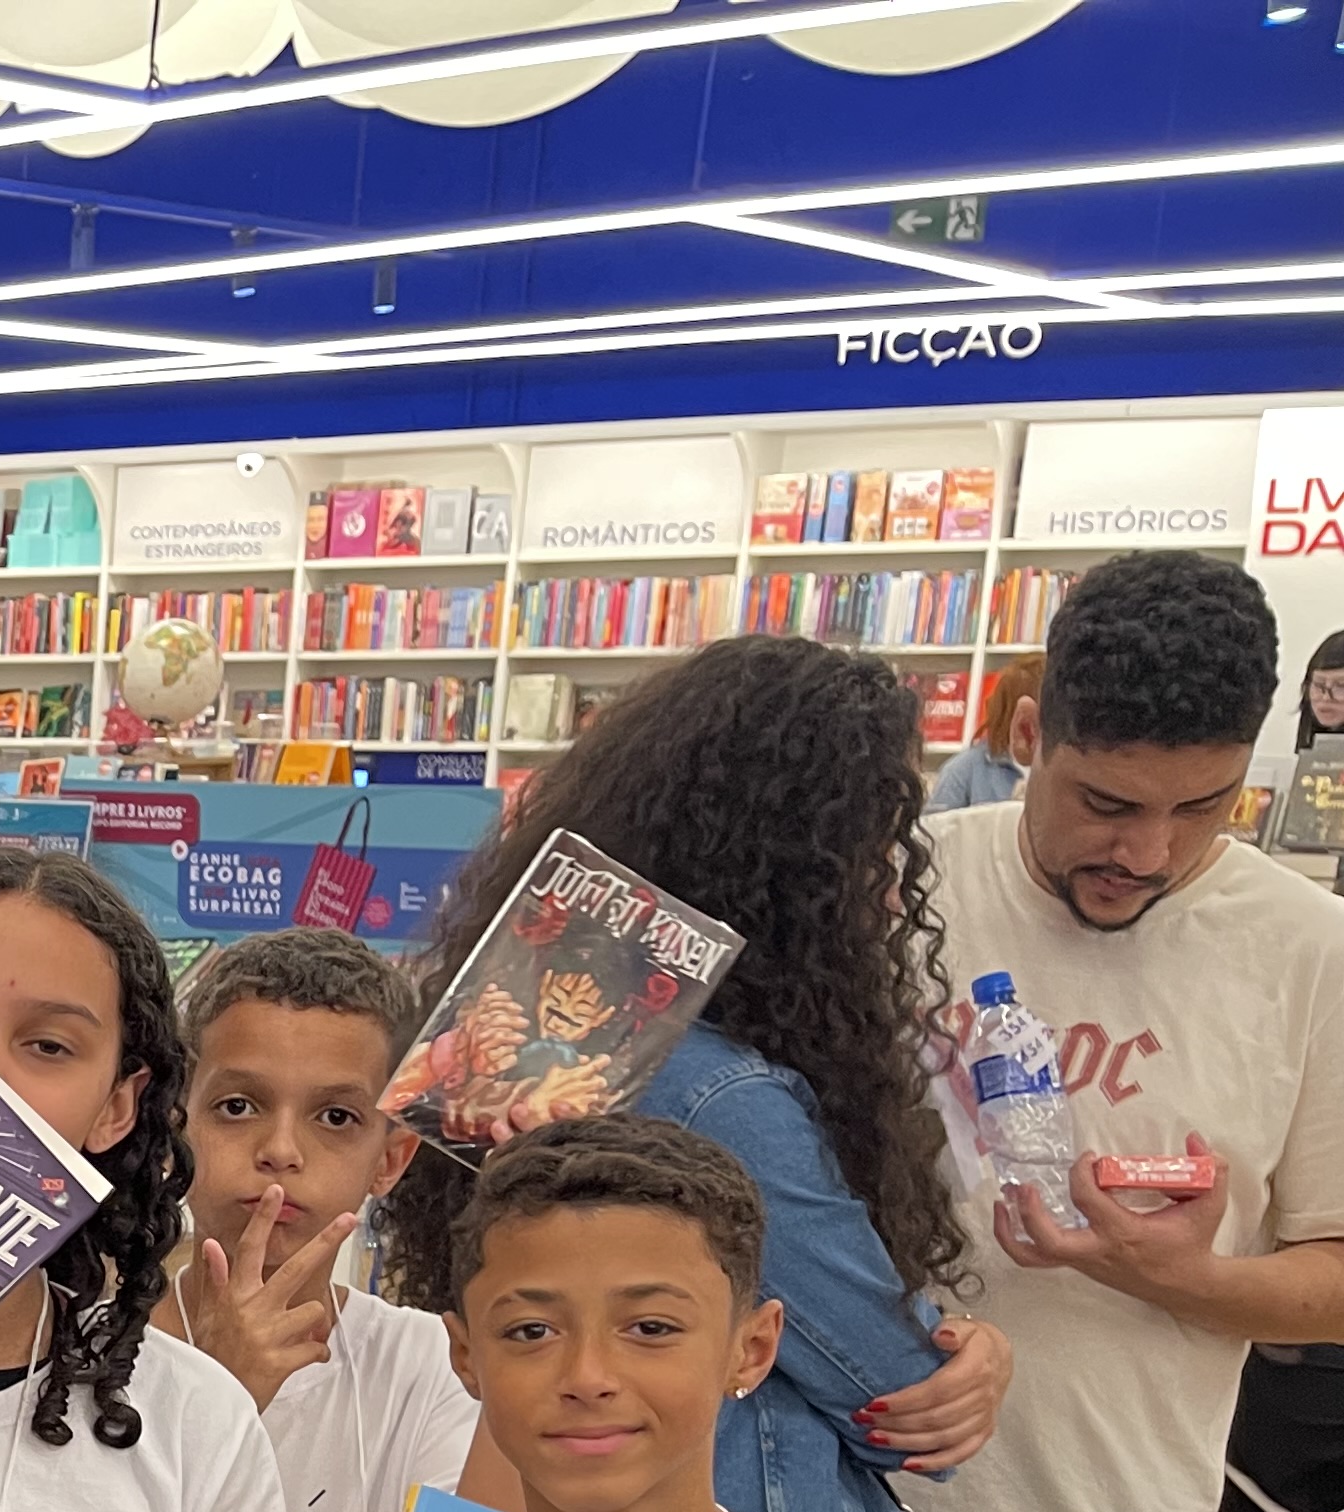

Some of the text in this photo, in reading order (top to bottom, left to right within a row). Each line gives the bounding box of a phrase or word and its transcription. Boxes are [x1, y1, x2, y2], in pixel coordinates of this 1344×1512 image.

[1050, 503, 1228, 535] HISTÓRICOS
[130, 520, 281, 541] CONTEMPORÂNEOS
[542, 519, 717, 547] ROMÂNTICOS
[144, 541, 263, 559] ESTRANGEIROS
[93, 803, 125, 818] MPRE
[189, 867, 282, 885] ECOBAG
[232, 887, 281, 900] LIVRO
[189, 899, 281, 916] SURPRESA!
